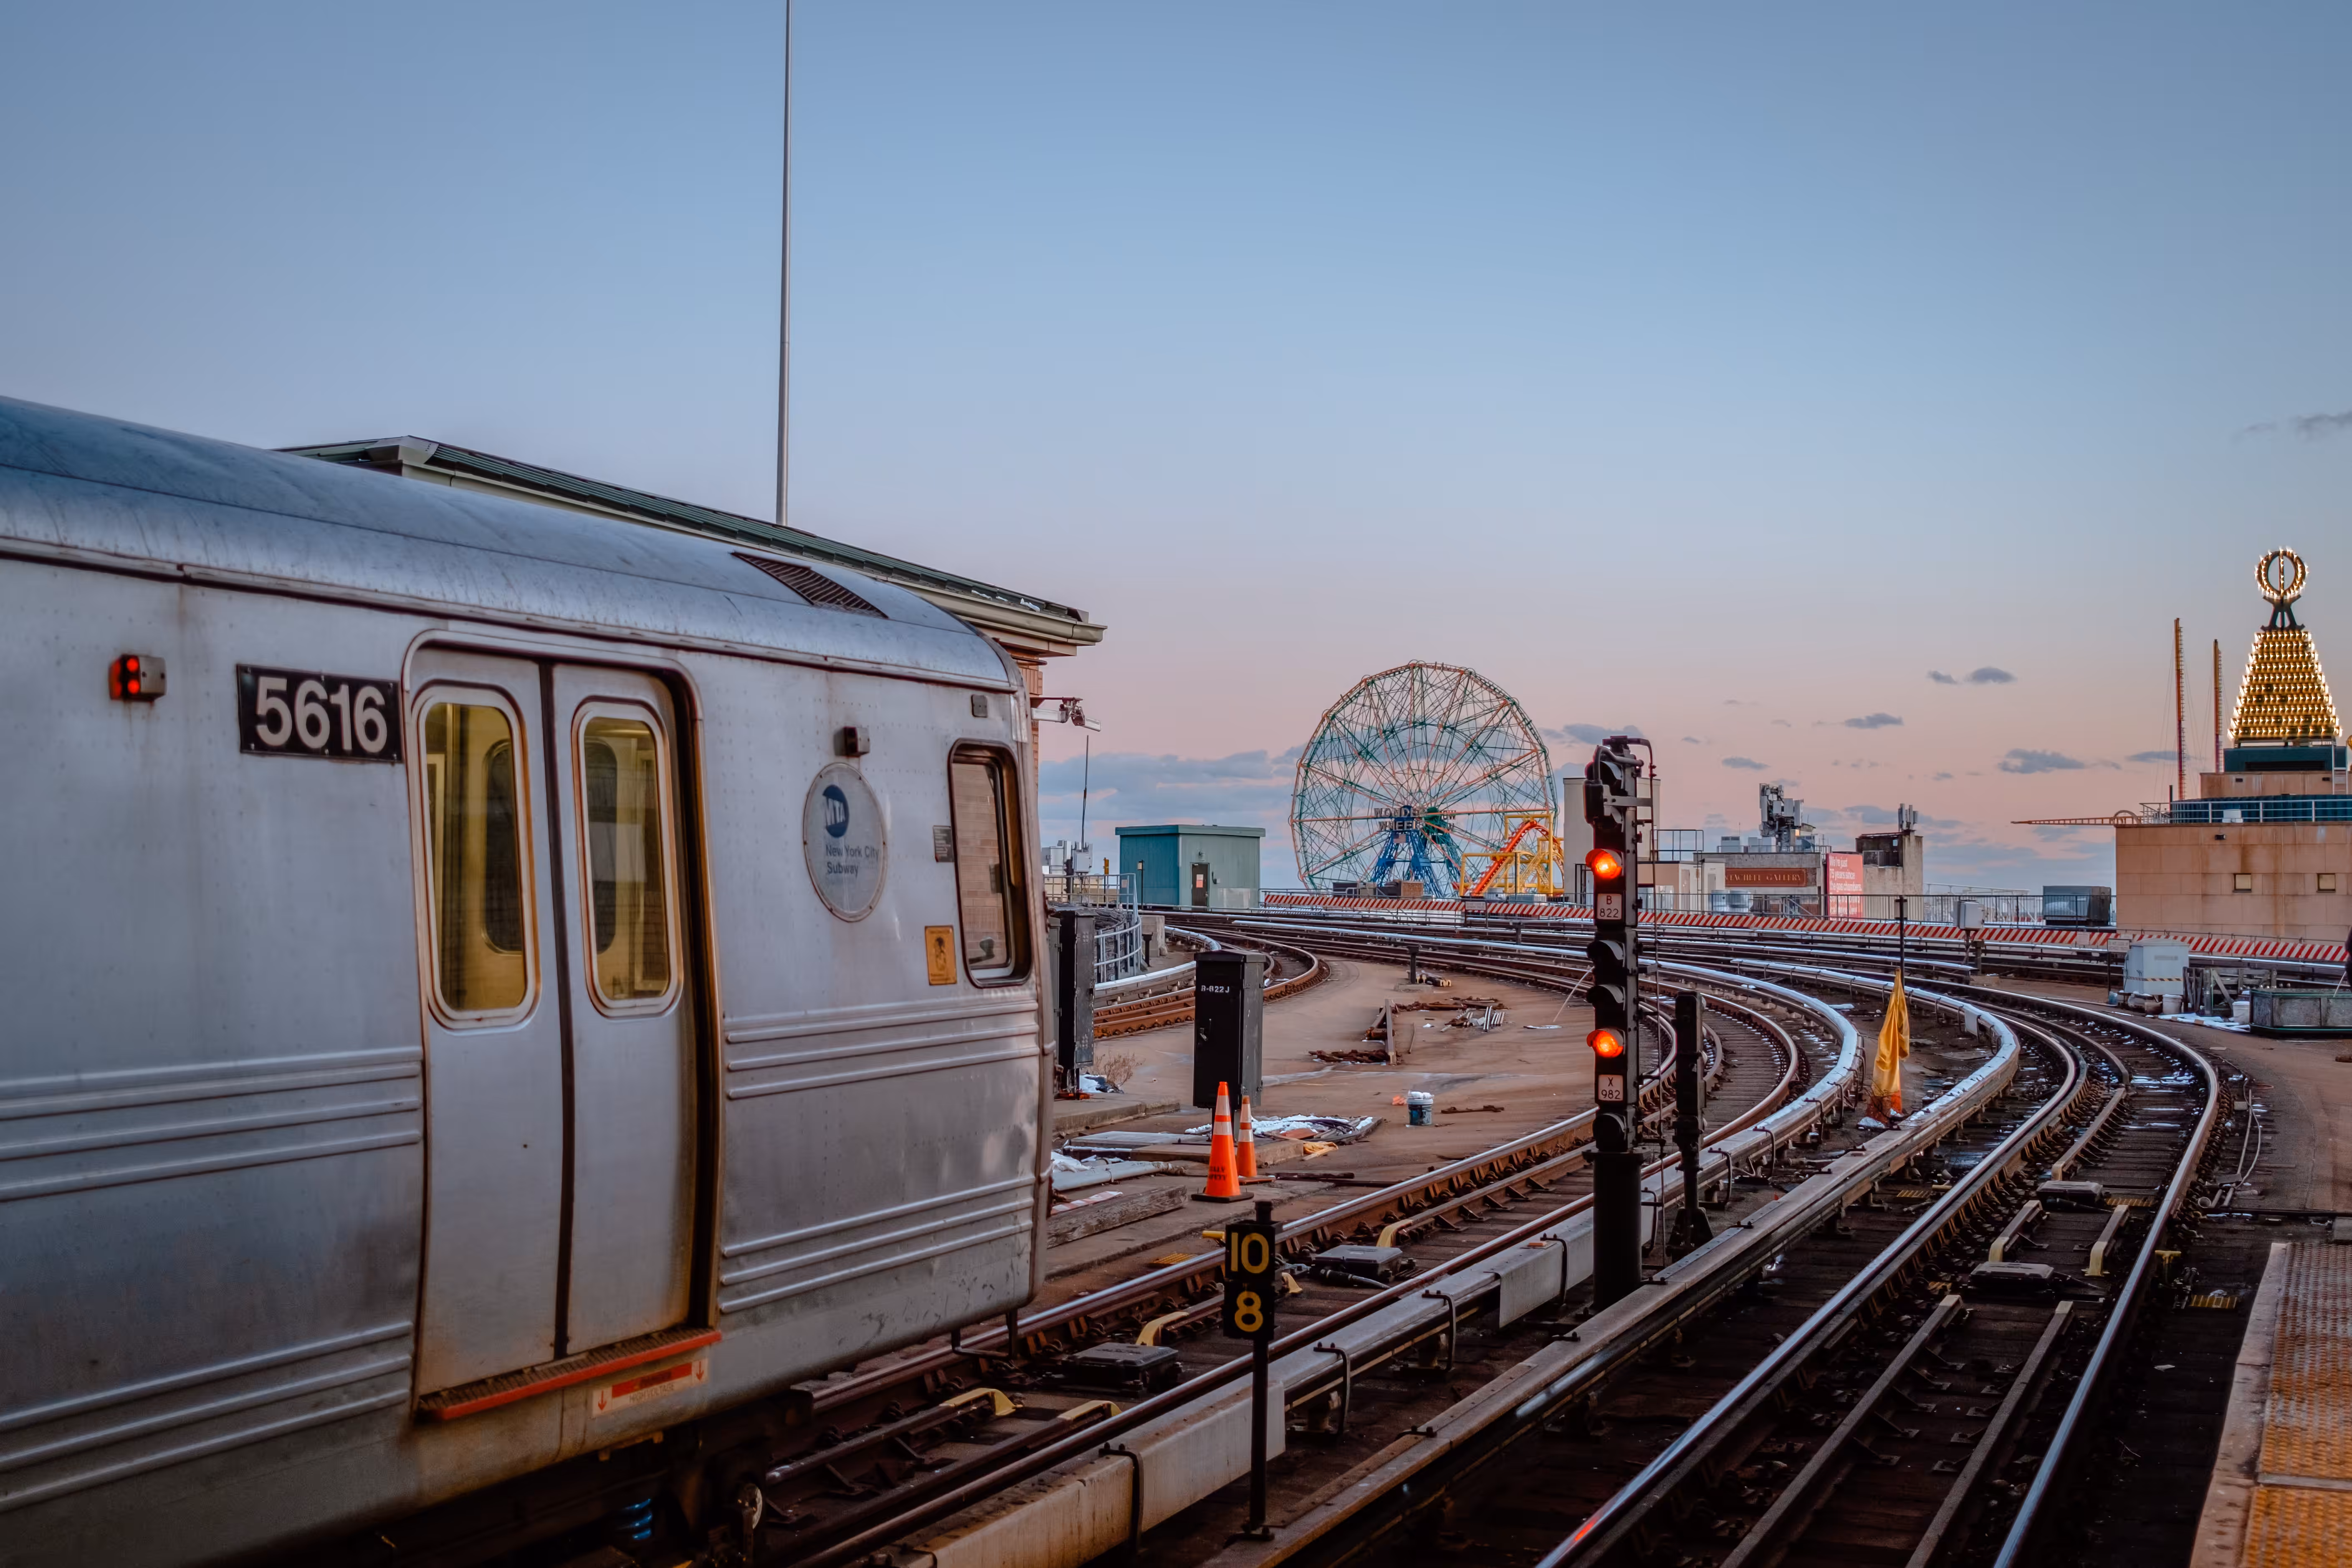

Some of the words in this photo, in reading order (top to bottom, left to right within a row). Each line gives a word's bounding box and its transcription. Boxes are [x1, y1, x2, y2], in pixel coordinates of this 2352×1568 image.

[255, 676, 388, 753] 5616
[825, 797, 846, 825] MTA
[826, 844, 843, 856] New
[844, 845, 862, 857] York
[865, 845, 880, 861] City
[1829, 855, 1840, 866] We're
[827, 862, 859, 878] Subway
[1830, 868, 1834, 878] 75
[1835, 871, 1845, 880] years
[1606, 895, 1612, 905] B
[1599, 908, 1619, 918] 822
[1608, 1077, 1614, 1087] X
[1601, 1089, 1621, 1099] 982
[1231, 1232, 1269, 1273] 10
[1234, 1291, 1263, 1332] 8
